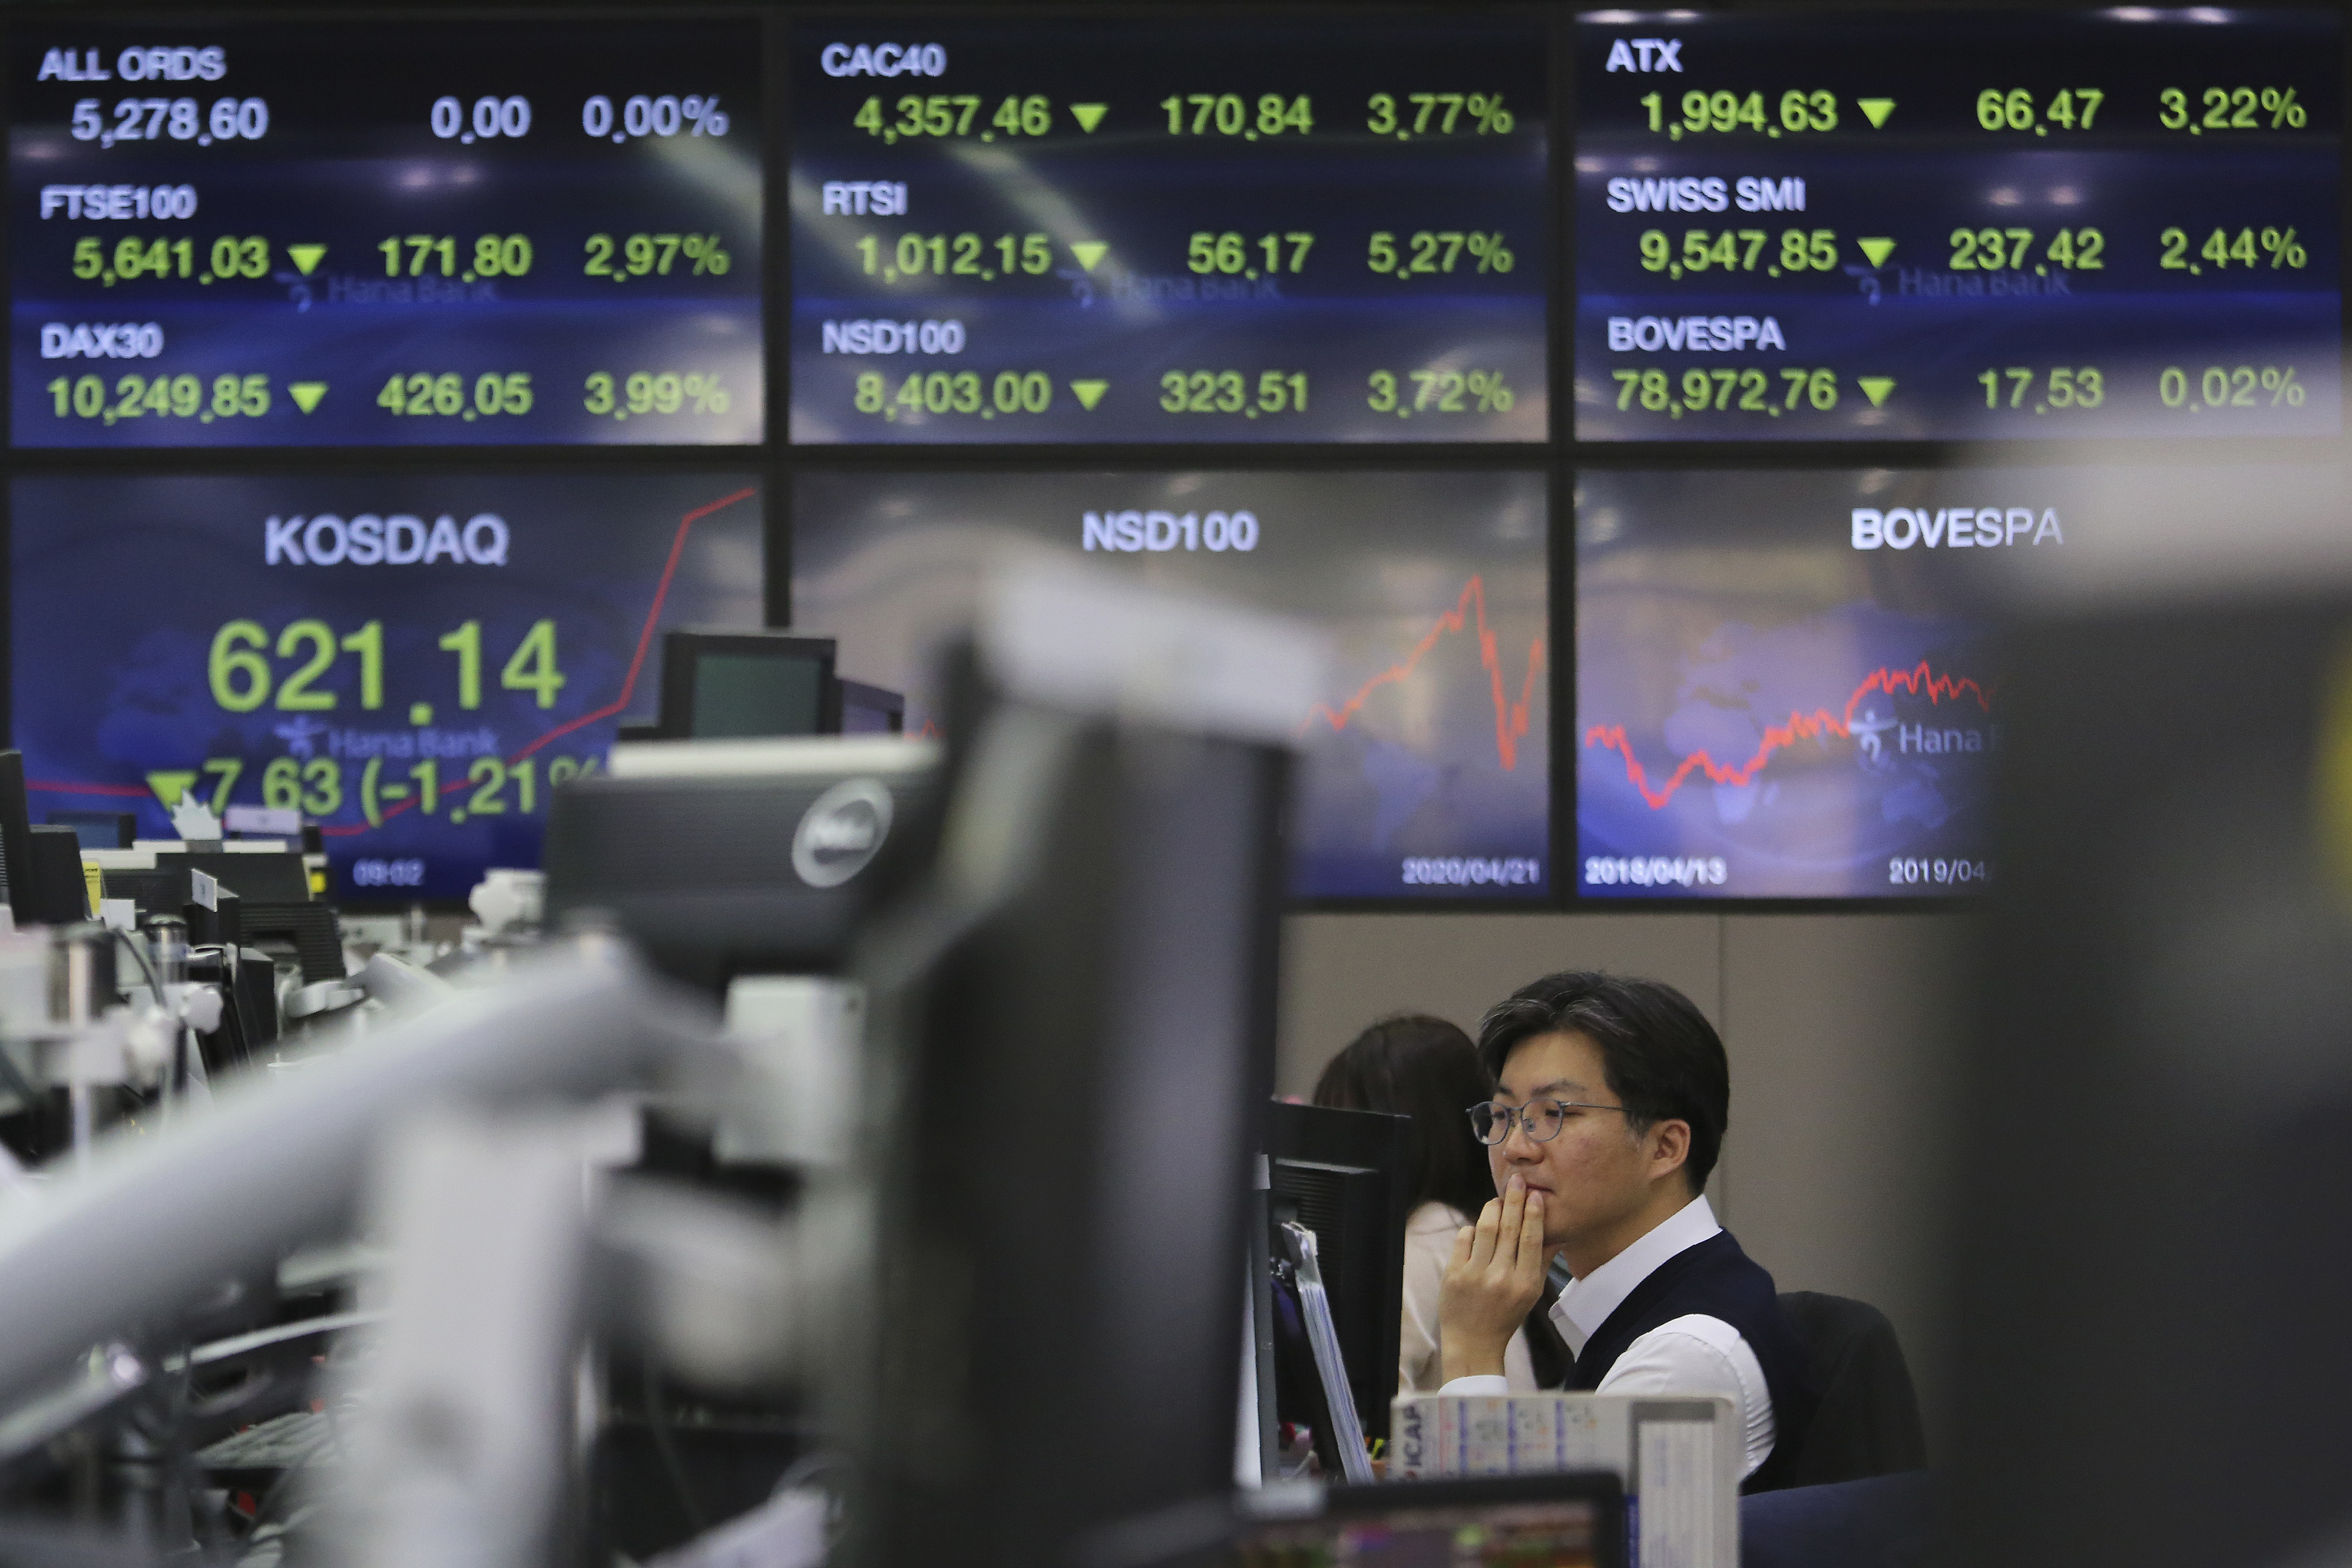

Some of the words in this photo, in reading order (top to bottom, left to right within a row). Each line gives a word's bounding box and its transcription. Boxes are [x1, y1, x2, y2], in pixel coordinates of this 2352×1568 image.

[38, 48, 111, 82] ALL
[117, 46, 226, 82] ORDS
[821, 42, 947, 78] CAC40
[1606, 38, 1682, 73] ATX
[71, 98, 269, 150] 5,278.60
[430, 96, 531, 145] 0.00
[582, 95, 729, 149] 0.00%
[854, 95, 1052, 144] 4,357.46
[1162, 94, 1314, 142] 170.84
[1368, 93, 1514, 141] 3.77%
[1641, 89, 1839, 140] 1,994.63
[1976, 88, 2104, 136] 66.47
[2159, 87, 2307, 136] 3.22%
[40, 185, 197, 220] FTSE100
[821, 181, 907, 216] RTSI
[1606, 177, 1729, 213] SWISS
[1735, 176, 1806, 212] SMI
[74, 236, 270, 286] 5,641.03
[379, 233, 533, 282] 171.80
[584, 234, 730, 283] 2.97%
[857, 233, 1052, 282] 1,012.15
[1188, 232, 1315, 280] 56.17
[1368, 232, 1514, 280] 5.27%
[1640, 229, 1838, 280] 9,547.85
[1949, 228, 2105, 276] 237.42
[2160, 227, 2308, 276] 2.44%
[41, 323, 163, 359] DAX30
[823, 319, 965, 355] NSD100
[1608, 316, 1785, 352] BOVESPA
[48, 374, 271, 426] 10,249.85
[377, 373, 534, 421] 426.05
[584, 373, 730, 420] 3.99%
[855, 371, 1053, 420] 8,403.00
[1161, 370, 1308, 419] 323.51
[1368, 370, 1515, 419] 3.72%
[1613, 369, 1838, 418] 78,972.76
[1978, 367, 2104, 414] 17.53
[2159, 366, 2305, 413] 0.02%
[265, 514, 509, 566] KOSDAQ
[1082, 511, 1259, 553] NSD100
[1850, 507, 2063, 550] BOVESPA
[209, 620, 565, 726] 621.14
[329, 728, 412, 757] Hana
[418, 728, 497, 757] Bank
[1899, 723, 1983, 753] Hana
[203, 757, 343, 816] 763
[1402, 857, 1539, 885] 2020/04/21
[1889, 857, 1989, 885] 2019/04
[1403, 1404, 1422, 1466] ICAP
